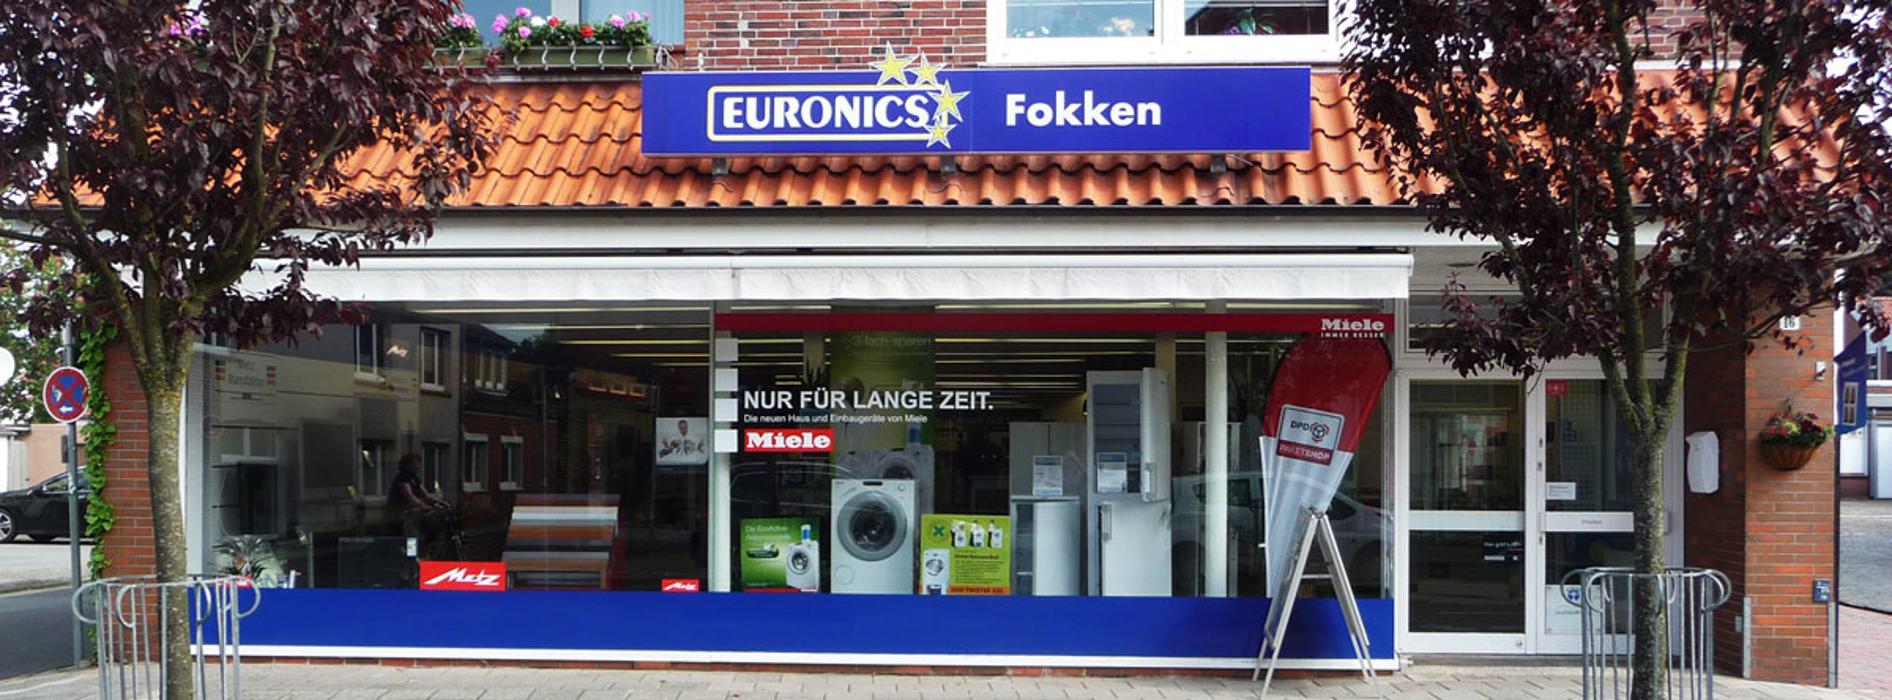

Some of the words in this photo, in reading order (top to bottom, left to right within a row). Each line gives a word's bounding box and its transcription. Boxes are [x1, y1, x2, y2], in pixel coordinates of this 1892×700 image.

[723, 96, 930, 129] EURONICS
[1006, 91, 1161, 126] Fokken
[1321, 318, 1385, 331] Miele
[744, 391, 793, 410] NUR
[800, 387, 846, 410] FÜR
[853, 391, 933, 410] LANGE
[939, 391, 994, 410] ZEIT.
[744, 414, 758, 423] Die
[760, 415, 786, 423] neuen
[788, 414, 810, 423] Haus
[812, 414, 829, 423] und
[887, 415, 904, 423] von
[905, 414, 928, 423] Miele
[1290, 420, 1310, 431] DPD
[746, 432, 831, 450] Miele
[424, 567, 501, 586] Metz
